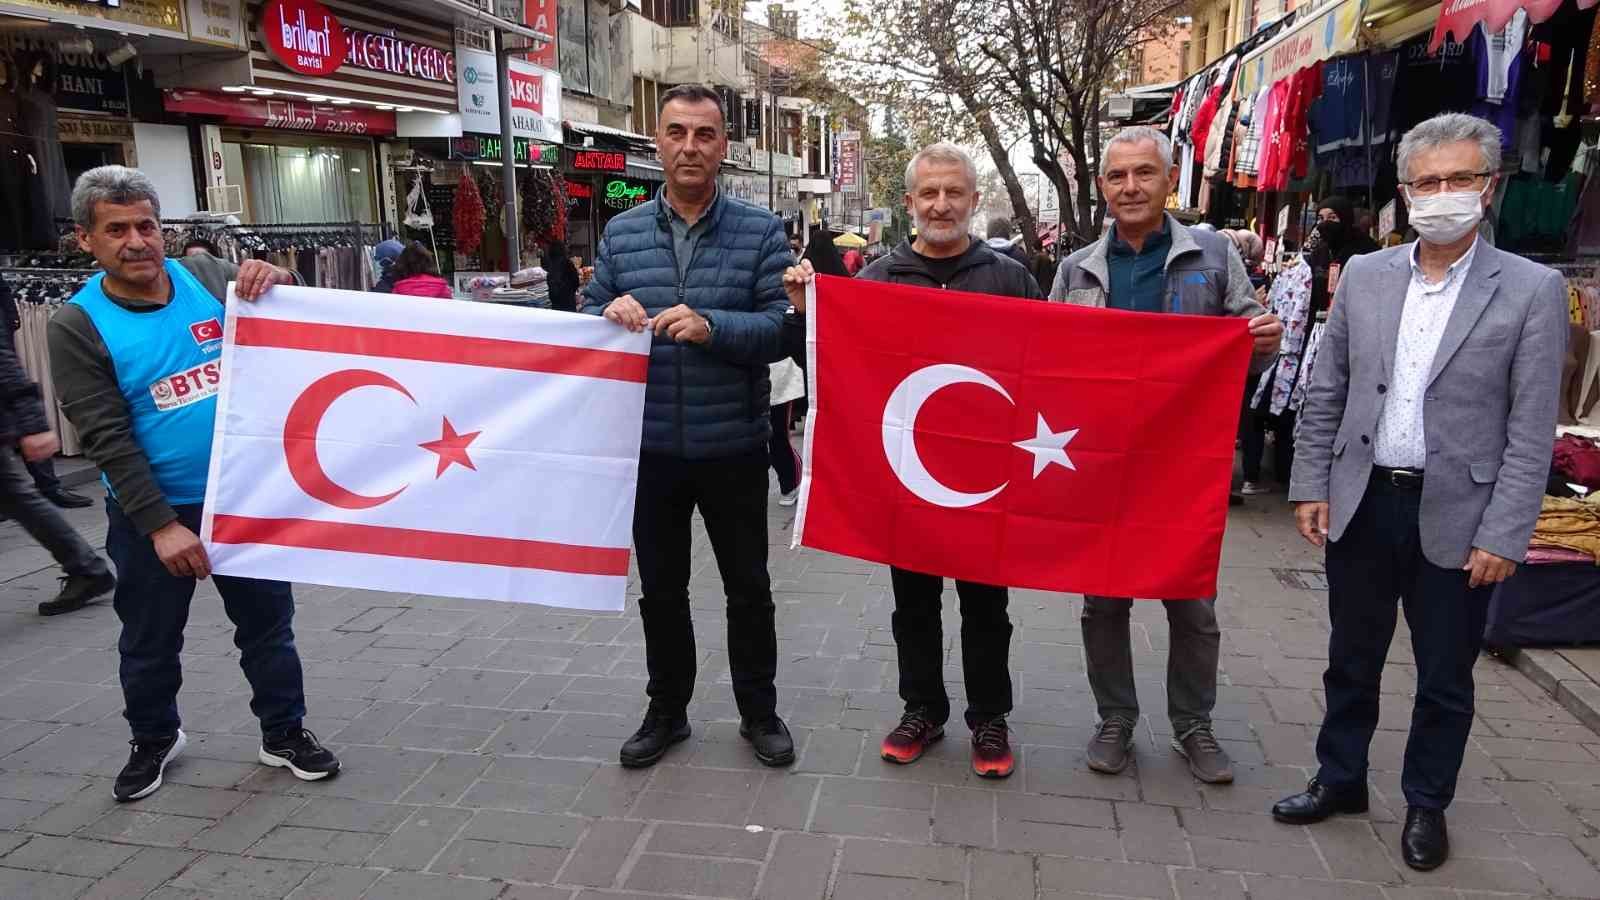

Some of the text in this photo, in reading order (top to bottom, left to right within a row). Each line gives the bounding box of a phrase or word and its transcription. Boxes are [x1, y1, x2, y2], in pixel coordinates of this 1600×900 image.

[280, 5, 331, 57] brillant
[510, 114, 543, 134] AHARAT
[574, 152, 625, 169] AKTAR
